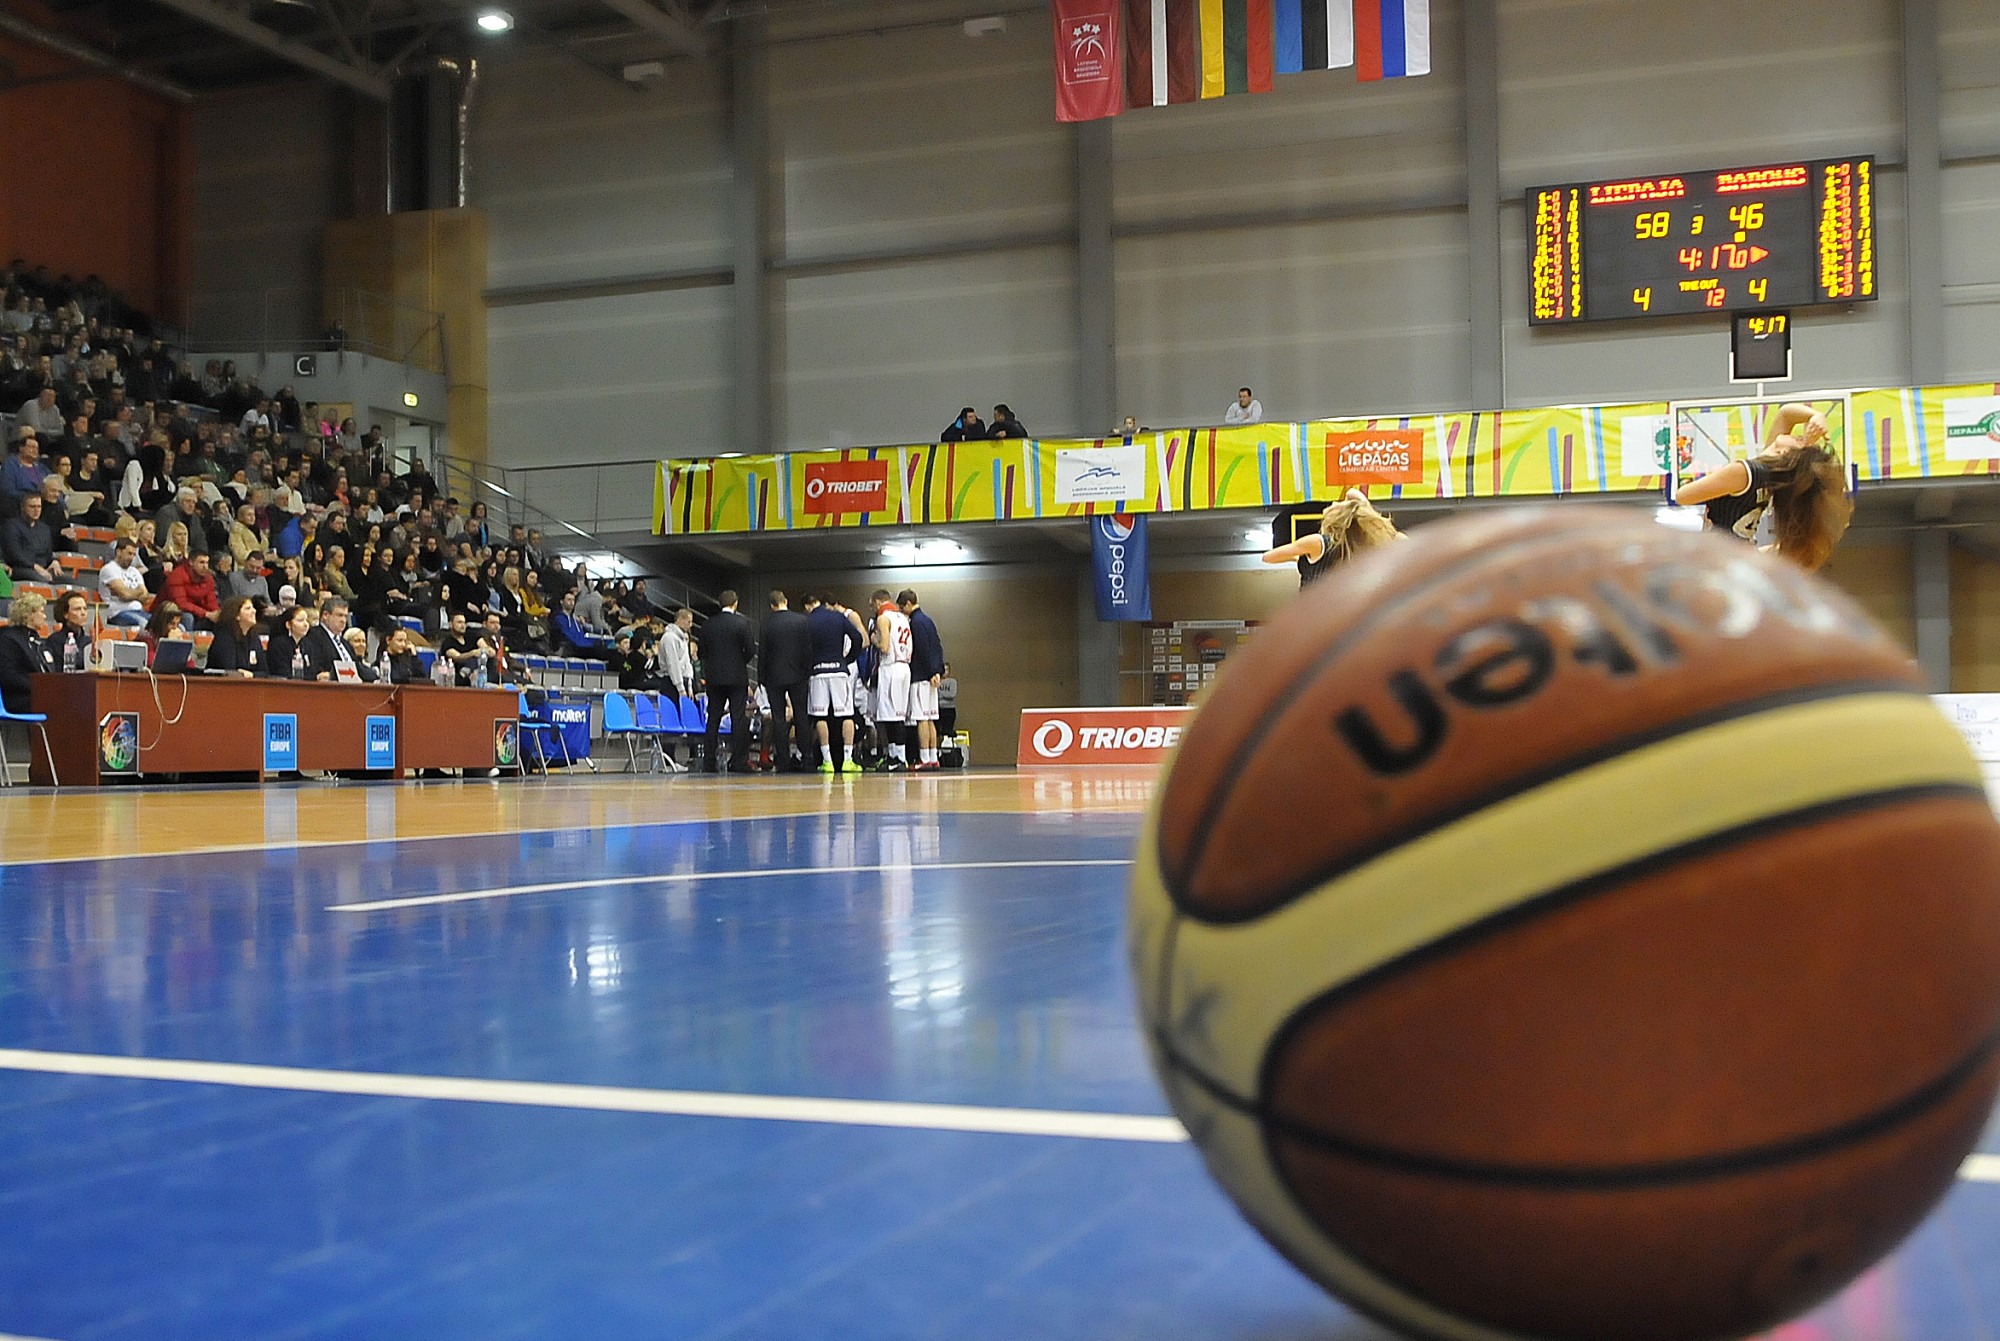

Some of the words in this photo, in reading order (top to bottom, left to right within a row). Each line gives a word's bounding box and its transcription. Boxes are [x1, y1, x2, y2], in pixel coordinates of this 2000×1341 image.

[1635, 211, 1670, 239] 58
[1690, 215, 1704, 235] 3
[1728, 202, 1764, 229] 46
[1632, 287, 1651, 312] 4
[1705, 287, 1725, 307] 12
[1748, 278, 1768, 302] 4
[1748, 315, 1786, 334] 4:17
[826, 480, 882, 494] TRIOBET
[1108, 544, 1128, 606] pepsi
[897, 626, 911, 646] 22
[552, 708, 587, 723] molten
[269, 723, 291, 740] FIBA
[370, 724, 390, 741] FIBA
[1078, 726, 1184, 749] TRIOBE
